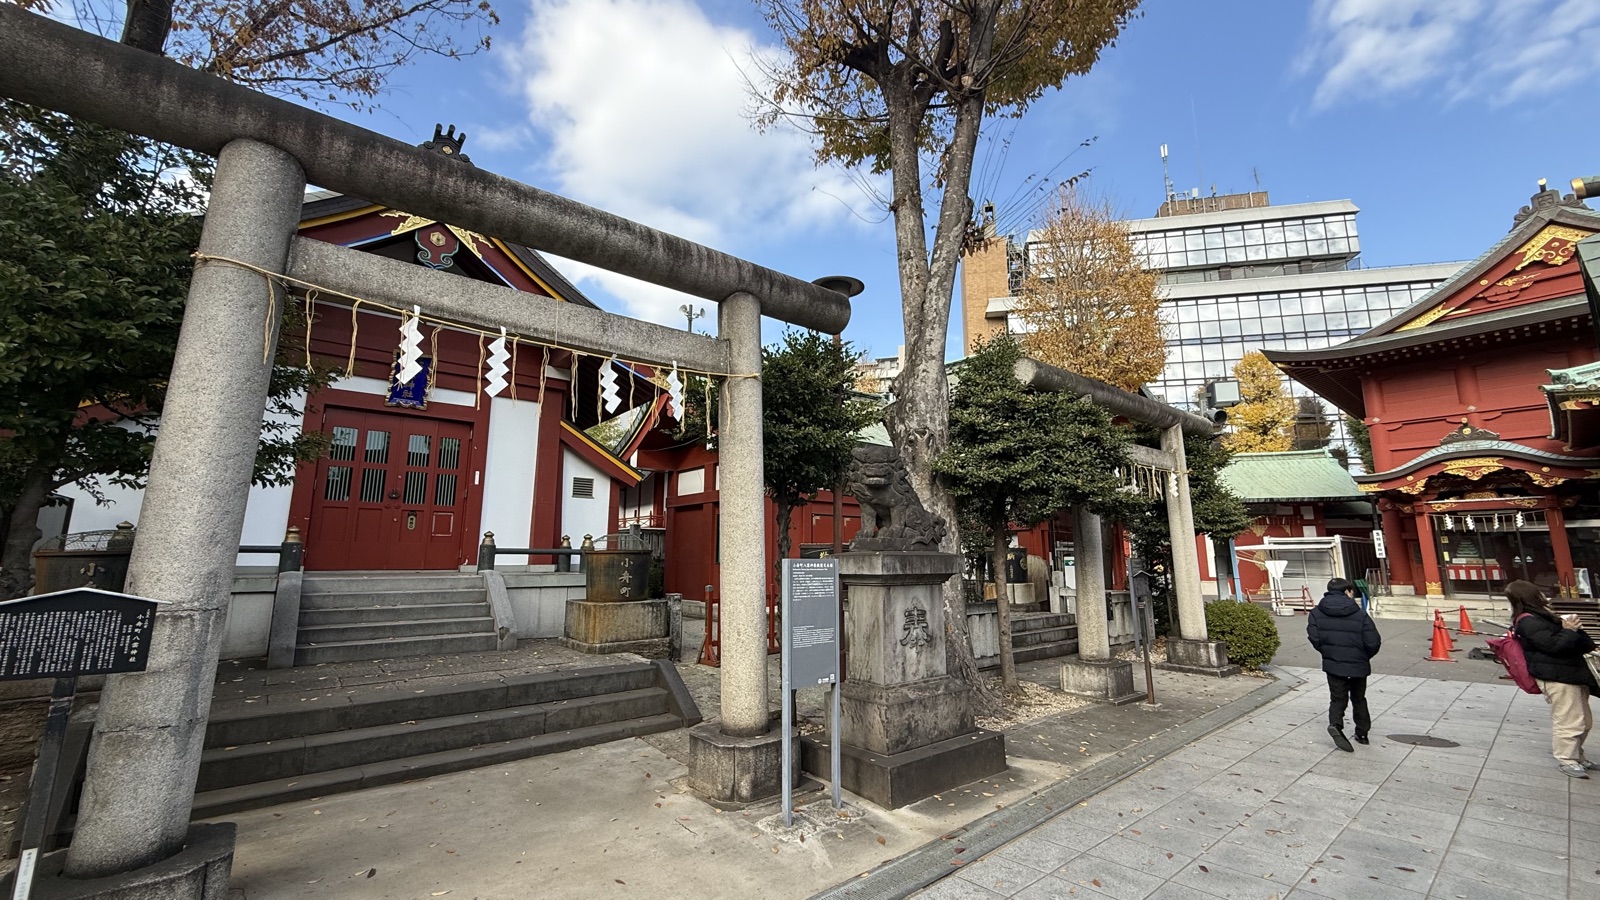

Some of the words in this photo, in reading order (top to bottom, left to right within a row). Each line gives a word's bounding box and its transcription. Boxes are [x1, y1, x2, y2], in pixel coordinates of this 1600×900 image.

[619, 558, 634, 598] 小舟町
[128, 613, 145, 663] 小舟町八雲神社
